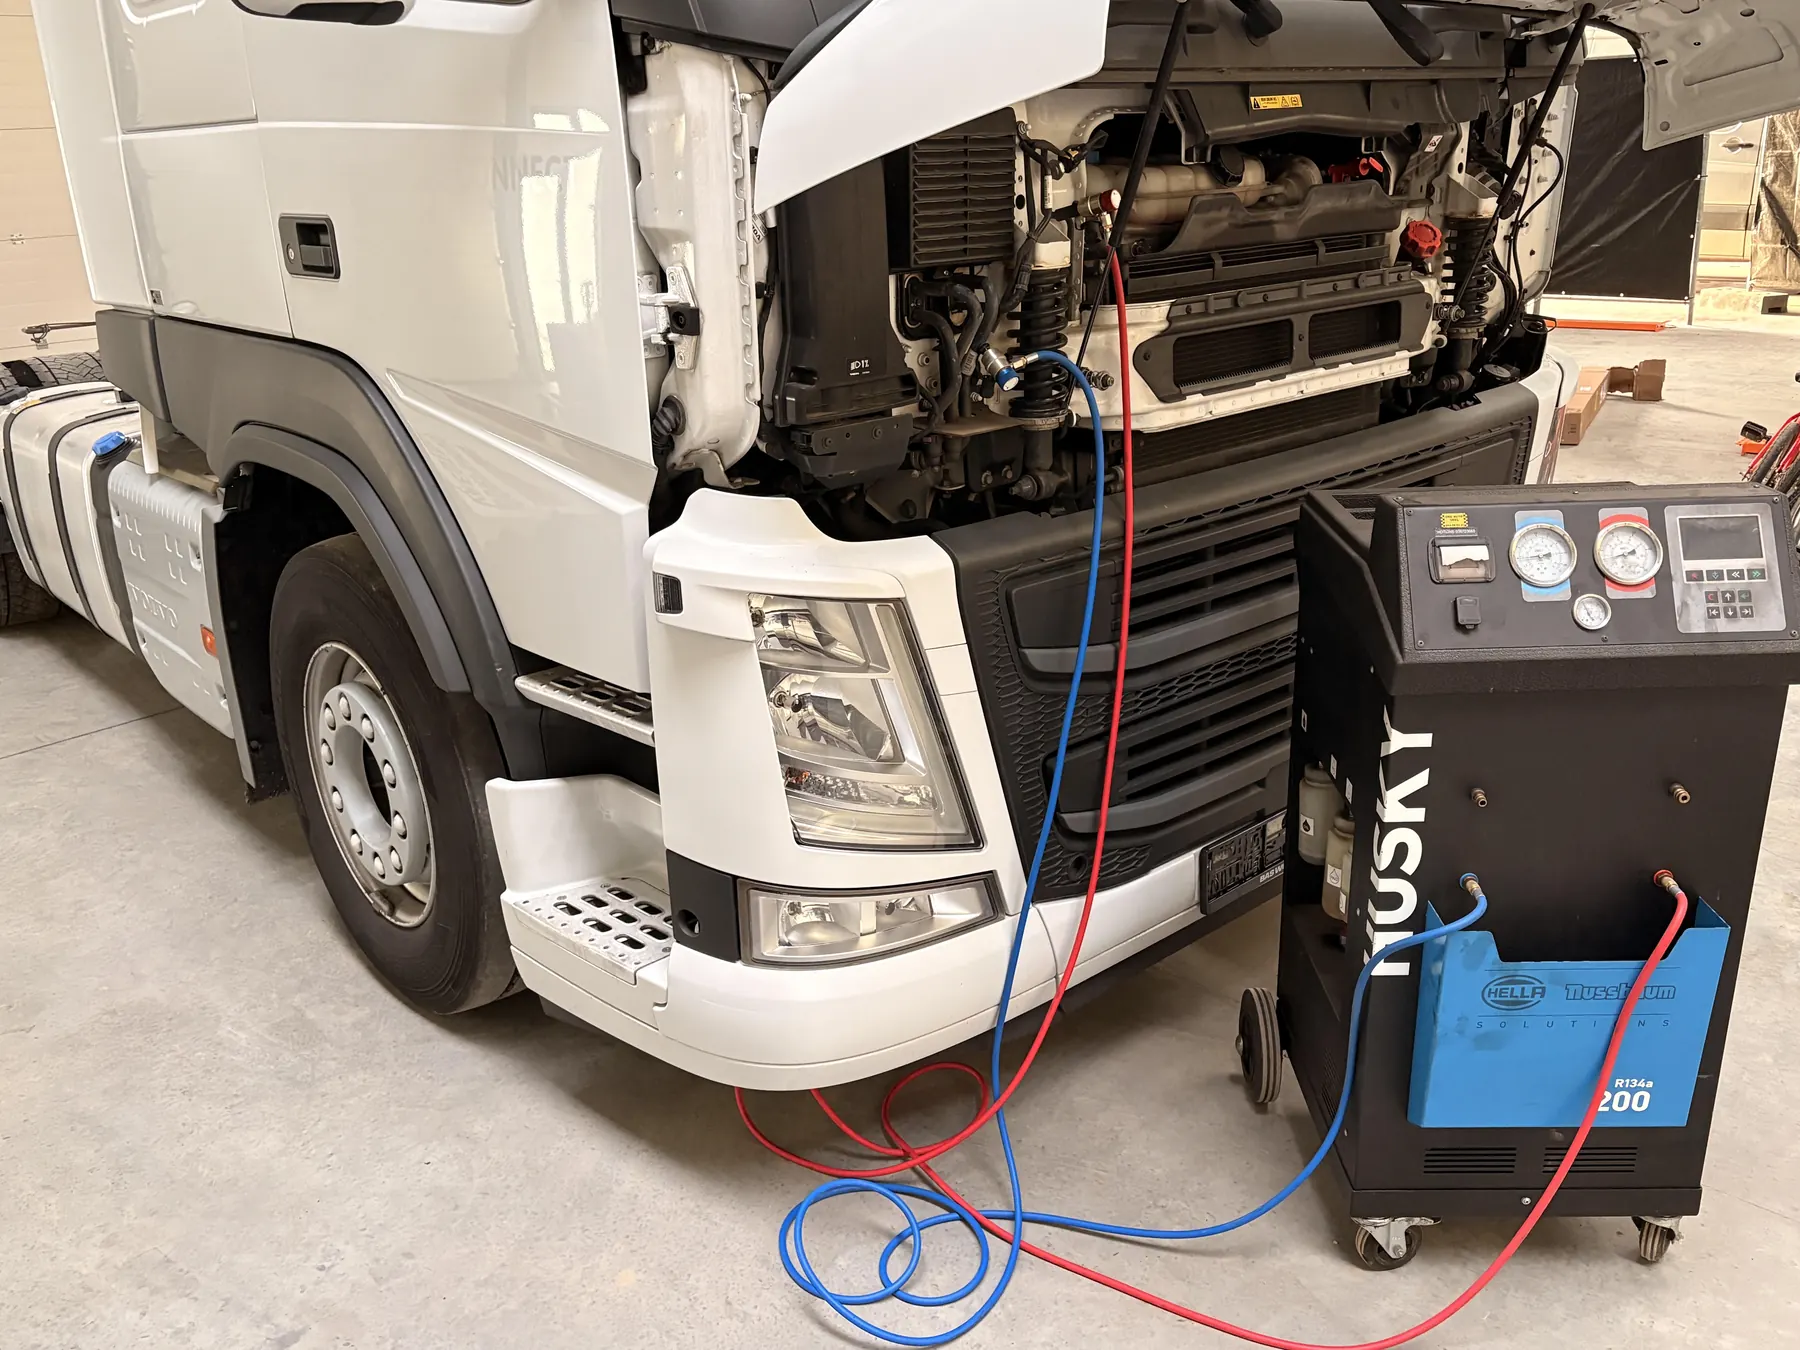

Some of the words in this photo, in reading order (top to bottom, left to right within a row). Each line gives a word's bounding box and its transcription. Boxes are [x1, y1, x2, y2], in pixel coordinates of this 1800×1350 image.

[1364, 704, 1433, 976] HUSKY
[1487, 985, 1547, 999] HELLA
[1565, 983, 1676, 1000] Nussbum
[1476, 1019, 1670, 1029] SOLUTINS
[1614, 1078, 1654, 1089] R134a
[1597, 1090, 1651, 1112] 200
